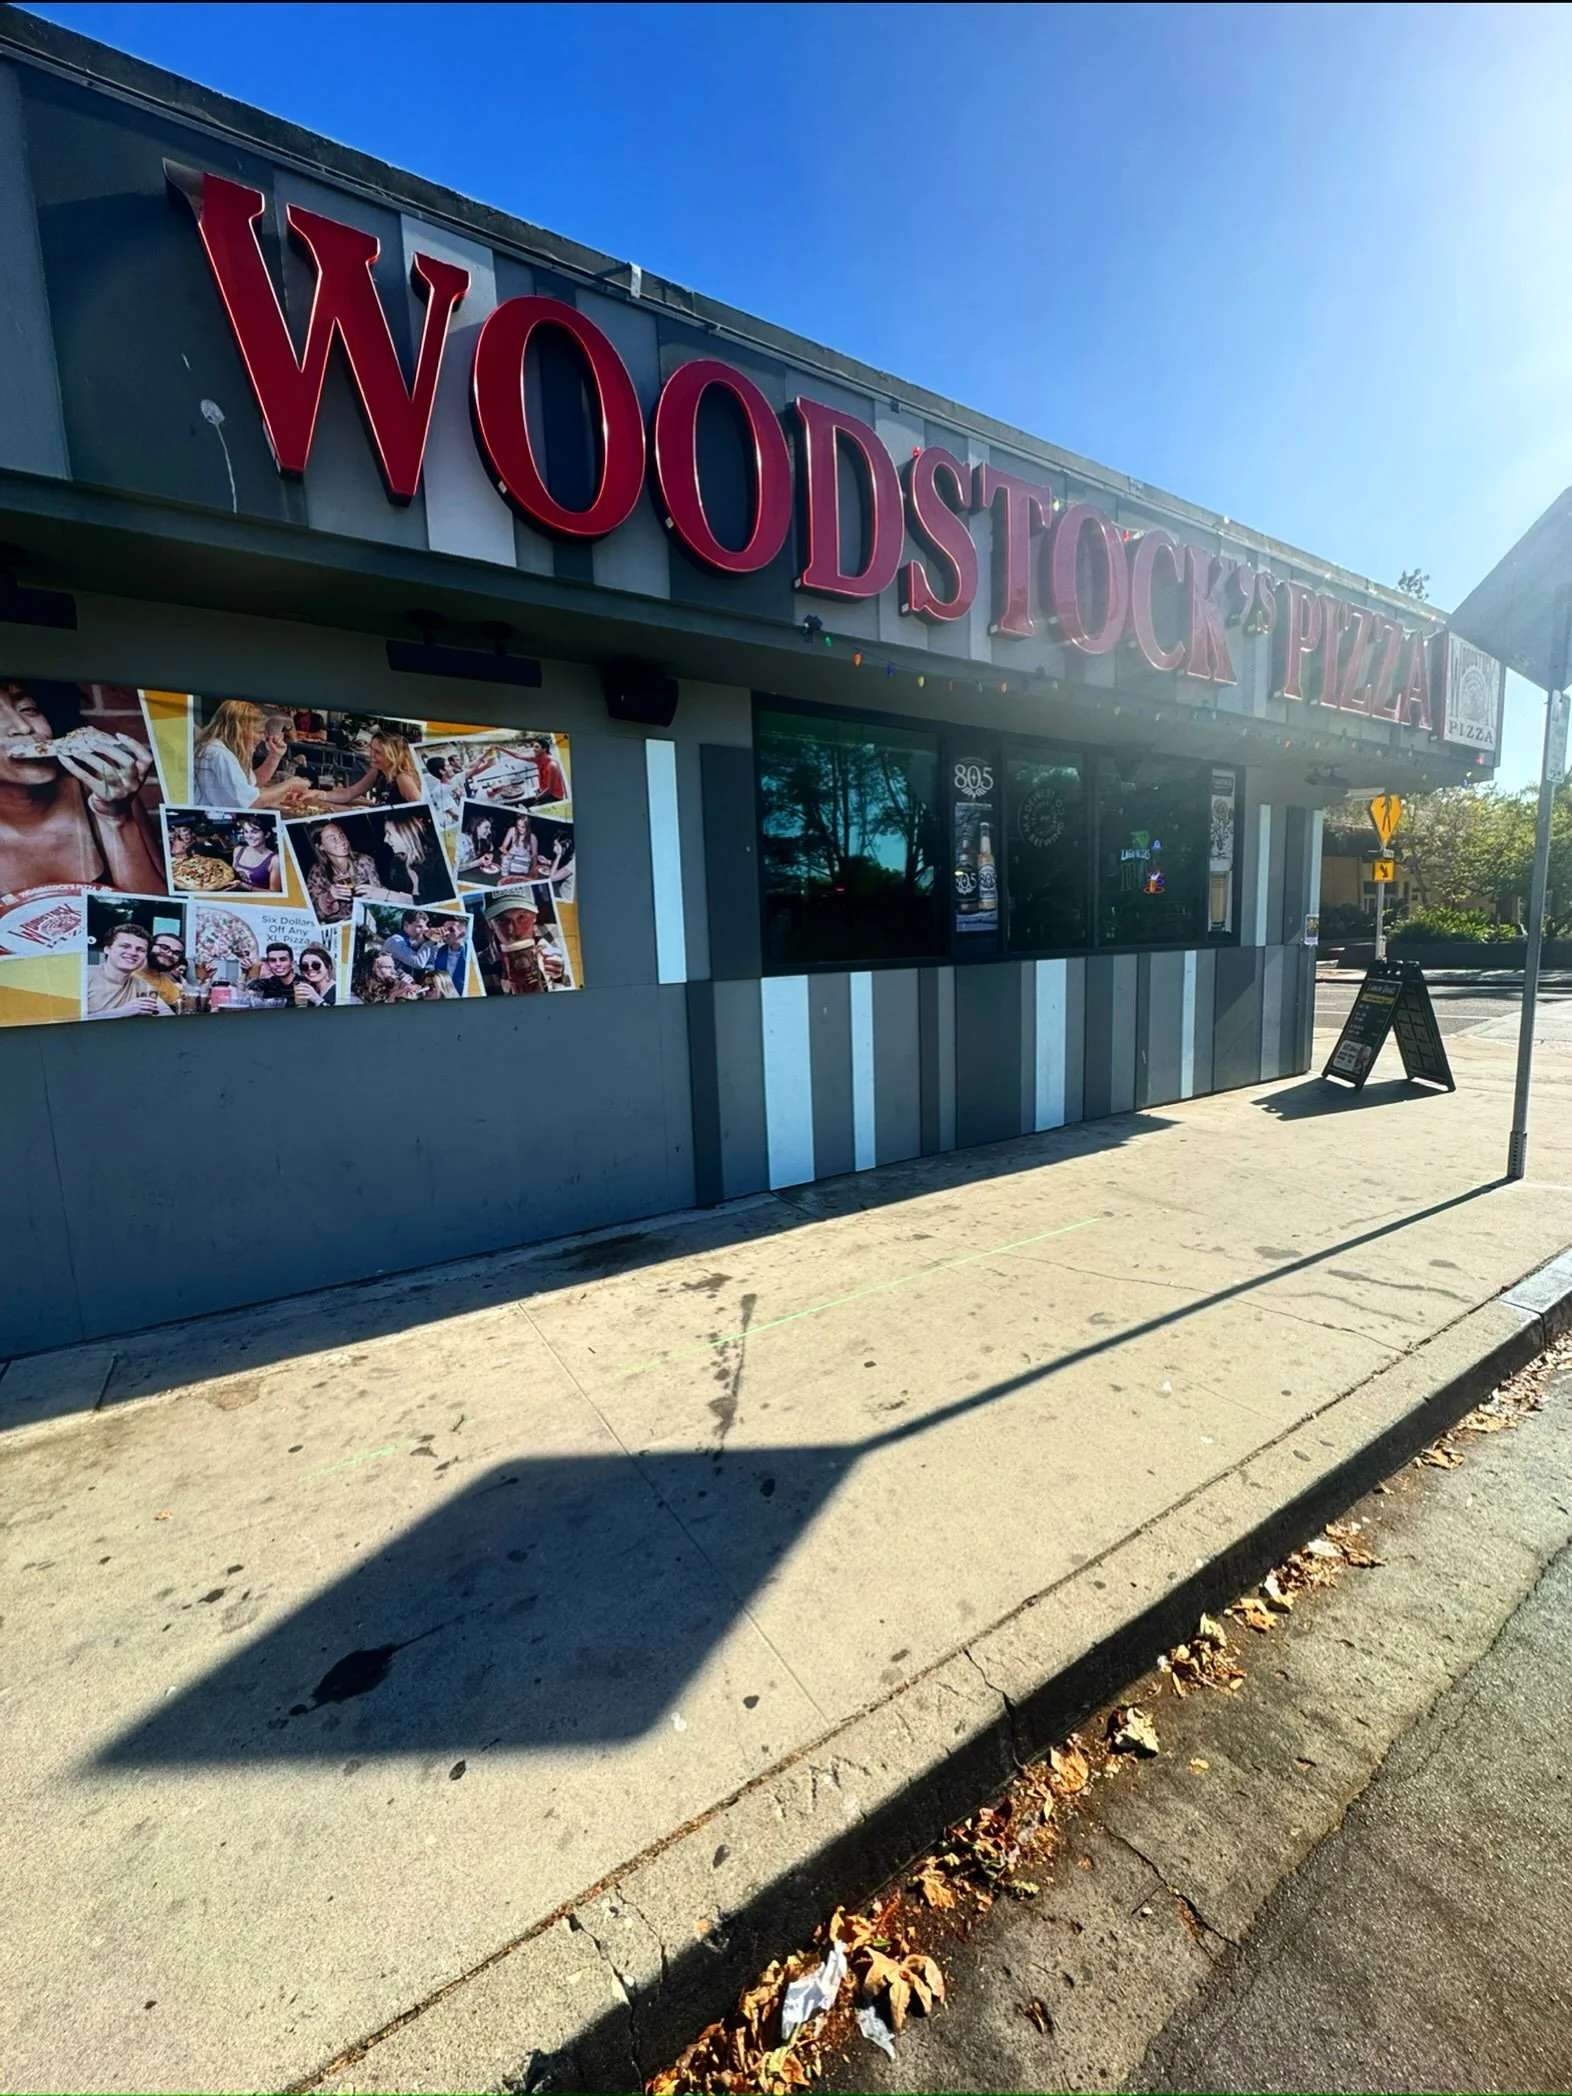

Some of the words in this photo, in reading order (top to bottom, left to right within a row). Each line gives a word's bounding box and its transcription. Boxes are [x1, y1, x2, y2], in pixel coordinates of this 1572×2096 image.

[165, 160, 1278, 686] WOODSTOCK'S
[1278, 581, 1433, 730] PIZZA
[1448, 720, 1494, 744] PIZZA
[954, 764, 994, 790] 805
[262, 915, 277, 924] Six
[280, 917, 315, 927] Dollars
[269, 925, 285, 934] Off
[288, 926, 308, 936] Any
[283, 935, 310, 944] Pizza
